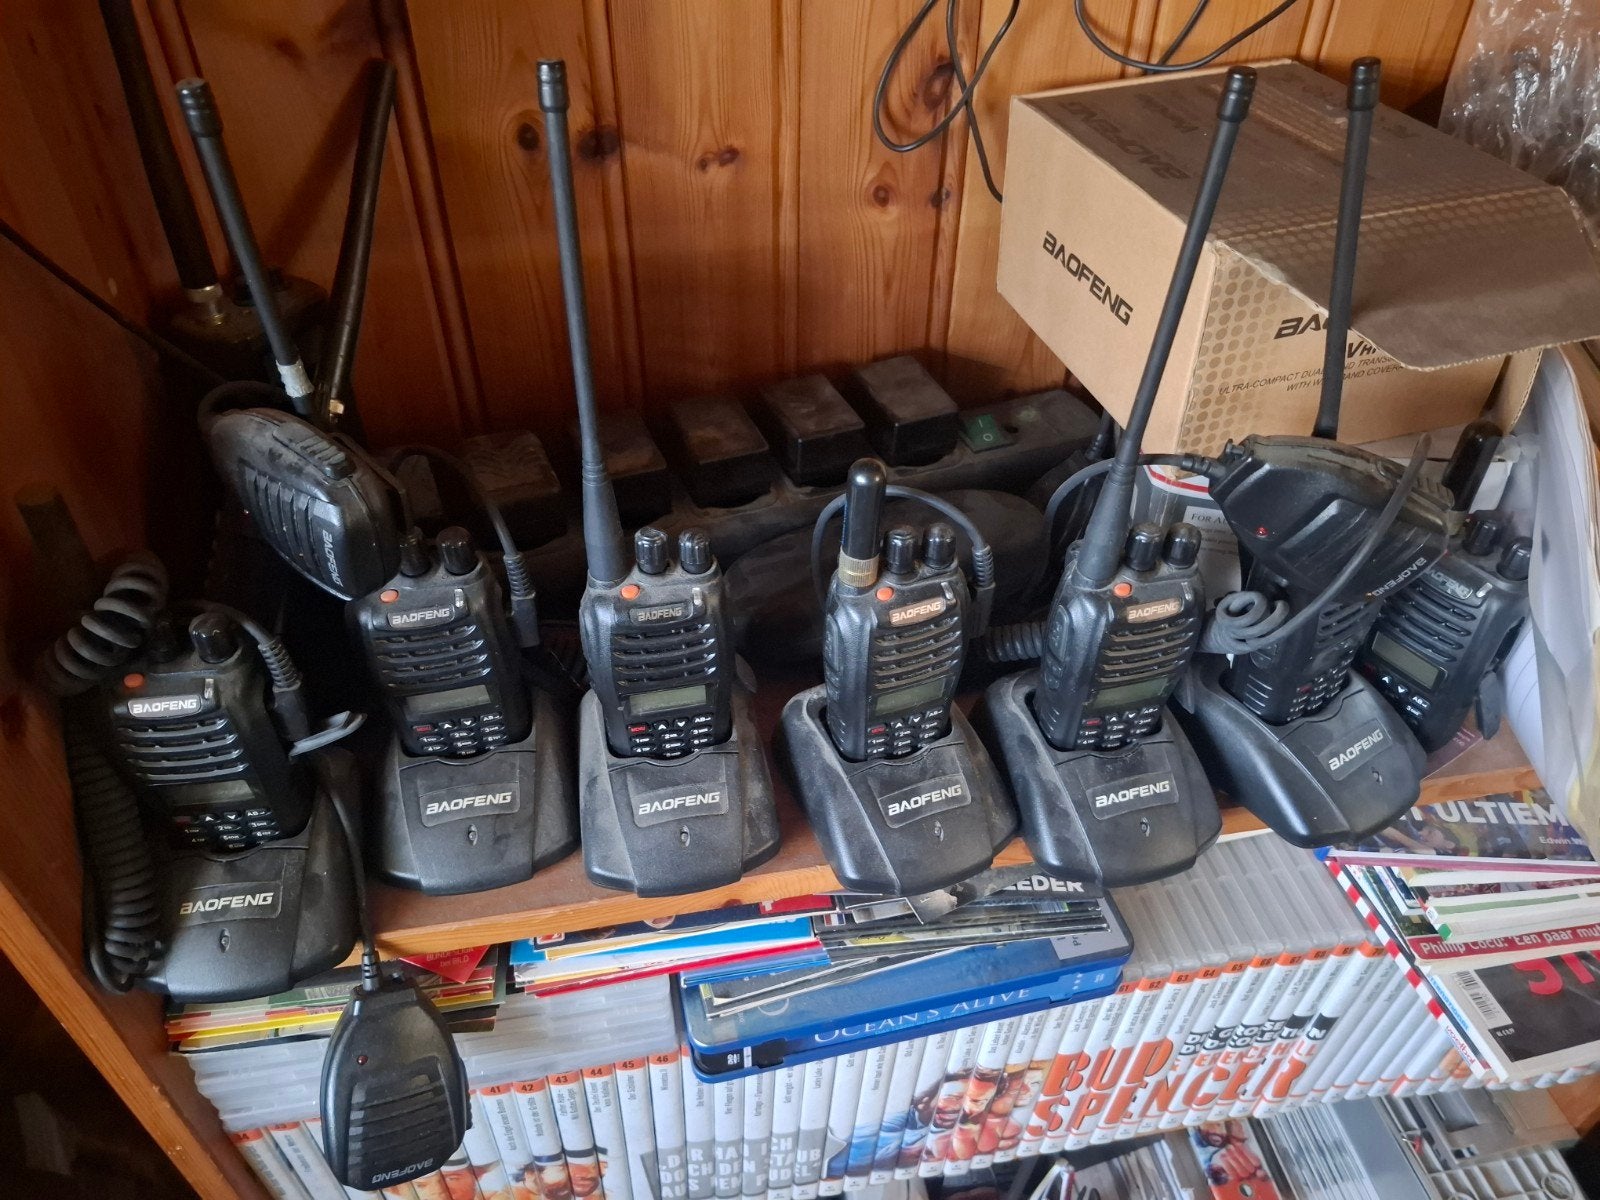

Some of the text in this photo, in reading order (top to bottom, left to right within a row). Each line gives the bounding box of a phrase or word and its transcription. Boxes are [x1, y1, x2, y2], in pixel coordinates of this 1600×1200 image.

[1042, 231, 1134, 326] BAOFENG
[1219, 371, 1300, 395] ULTRA-COMPACT
[1286, 381, 1311, 392] WITH
[322, 529, 344, 588] BAOFENG
[1372, 557, 1427, 598] BAOFENG
[392, 608, 450, 624] BAOFENG
[638, 607, 682, 622] BAOFENG
[892, 601, 941, 623] BAOFENG
[1128, 602, 1180, 619] BAOFENG
[132, 699, 197, 714] BAOFENG
[1329, 729, 1383, 771] BAOFENG
[426, 792, 512, 815] BAOFENG
[638, 792, 720, 815] BAOFENG
[888, 784, 962, 816] BAOFENG
[1095, 781, 1170, 807] BAOFENG
[1440, 800, 1569, 826] ULTIEM
[1539, 836, 1571, 845] Edwin
[180, 892, 273, 914] BAOFENG
[1542, 929, 1573, 943] paar
[1176, 974, 1189, 982] 63
[1203, 969, 1216, 977] 64
[1231, 963, 1244, 971] 65
[951, 988, 1031, 1013] ALIVE
[622, 1060, 635, 1068] 45
[657, 1055, 668, 1063] 46
[1041, 1036, 1174, 1097] BUD
[591, 1068, 602, 1076] 44
[372, 1158, 434, 1184] BAOFENG
